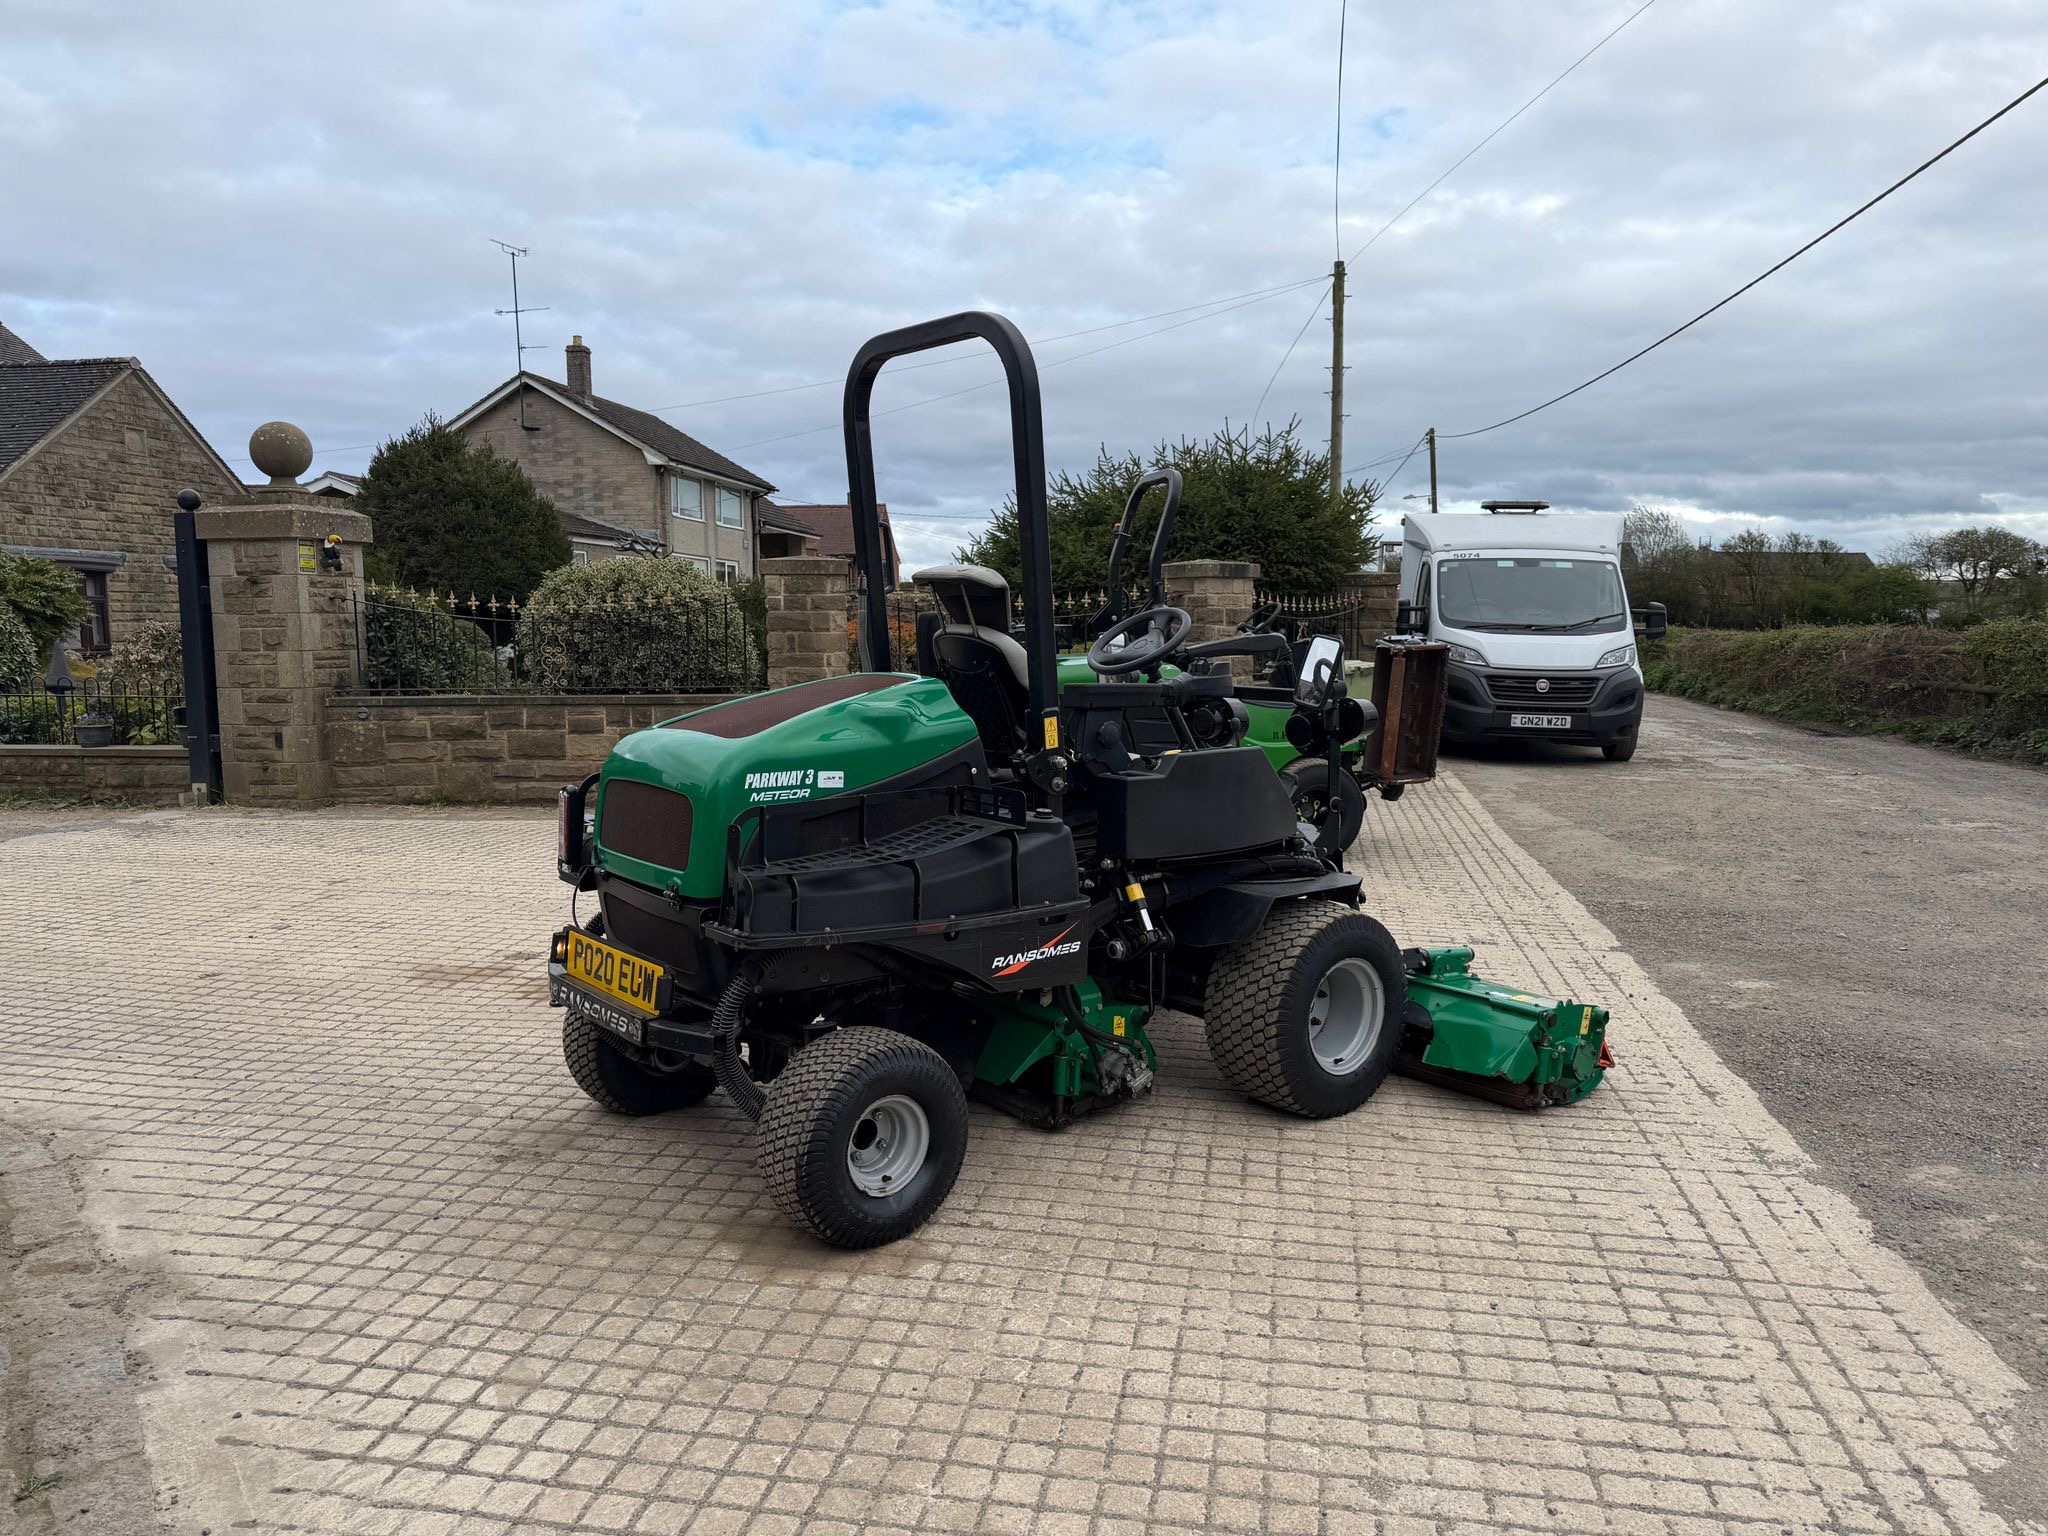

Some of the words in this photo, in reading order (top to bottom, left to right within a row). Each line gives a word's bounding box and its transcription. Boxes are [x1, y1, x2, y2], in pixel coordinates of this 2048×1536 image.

[1520, 716, 1544, 726] GN21
[1546, 716, 1567, 727] WZD
[744, 770, 804, 789] PARKWAY
[805, 769, 814, 785] 3
[750, 788, 811, 802] METEOR
[991, 941, 1081, 969] RANSOMES
[574, 937, 615, 986] PO20
[618, 957, 655, 1004] EUW
[560, 987, 628, 1033] RANSOMES
